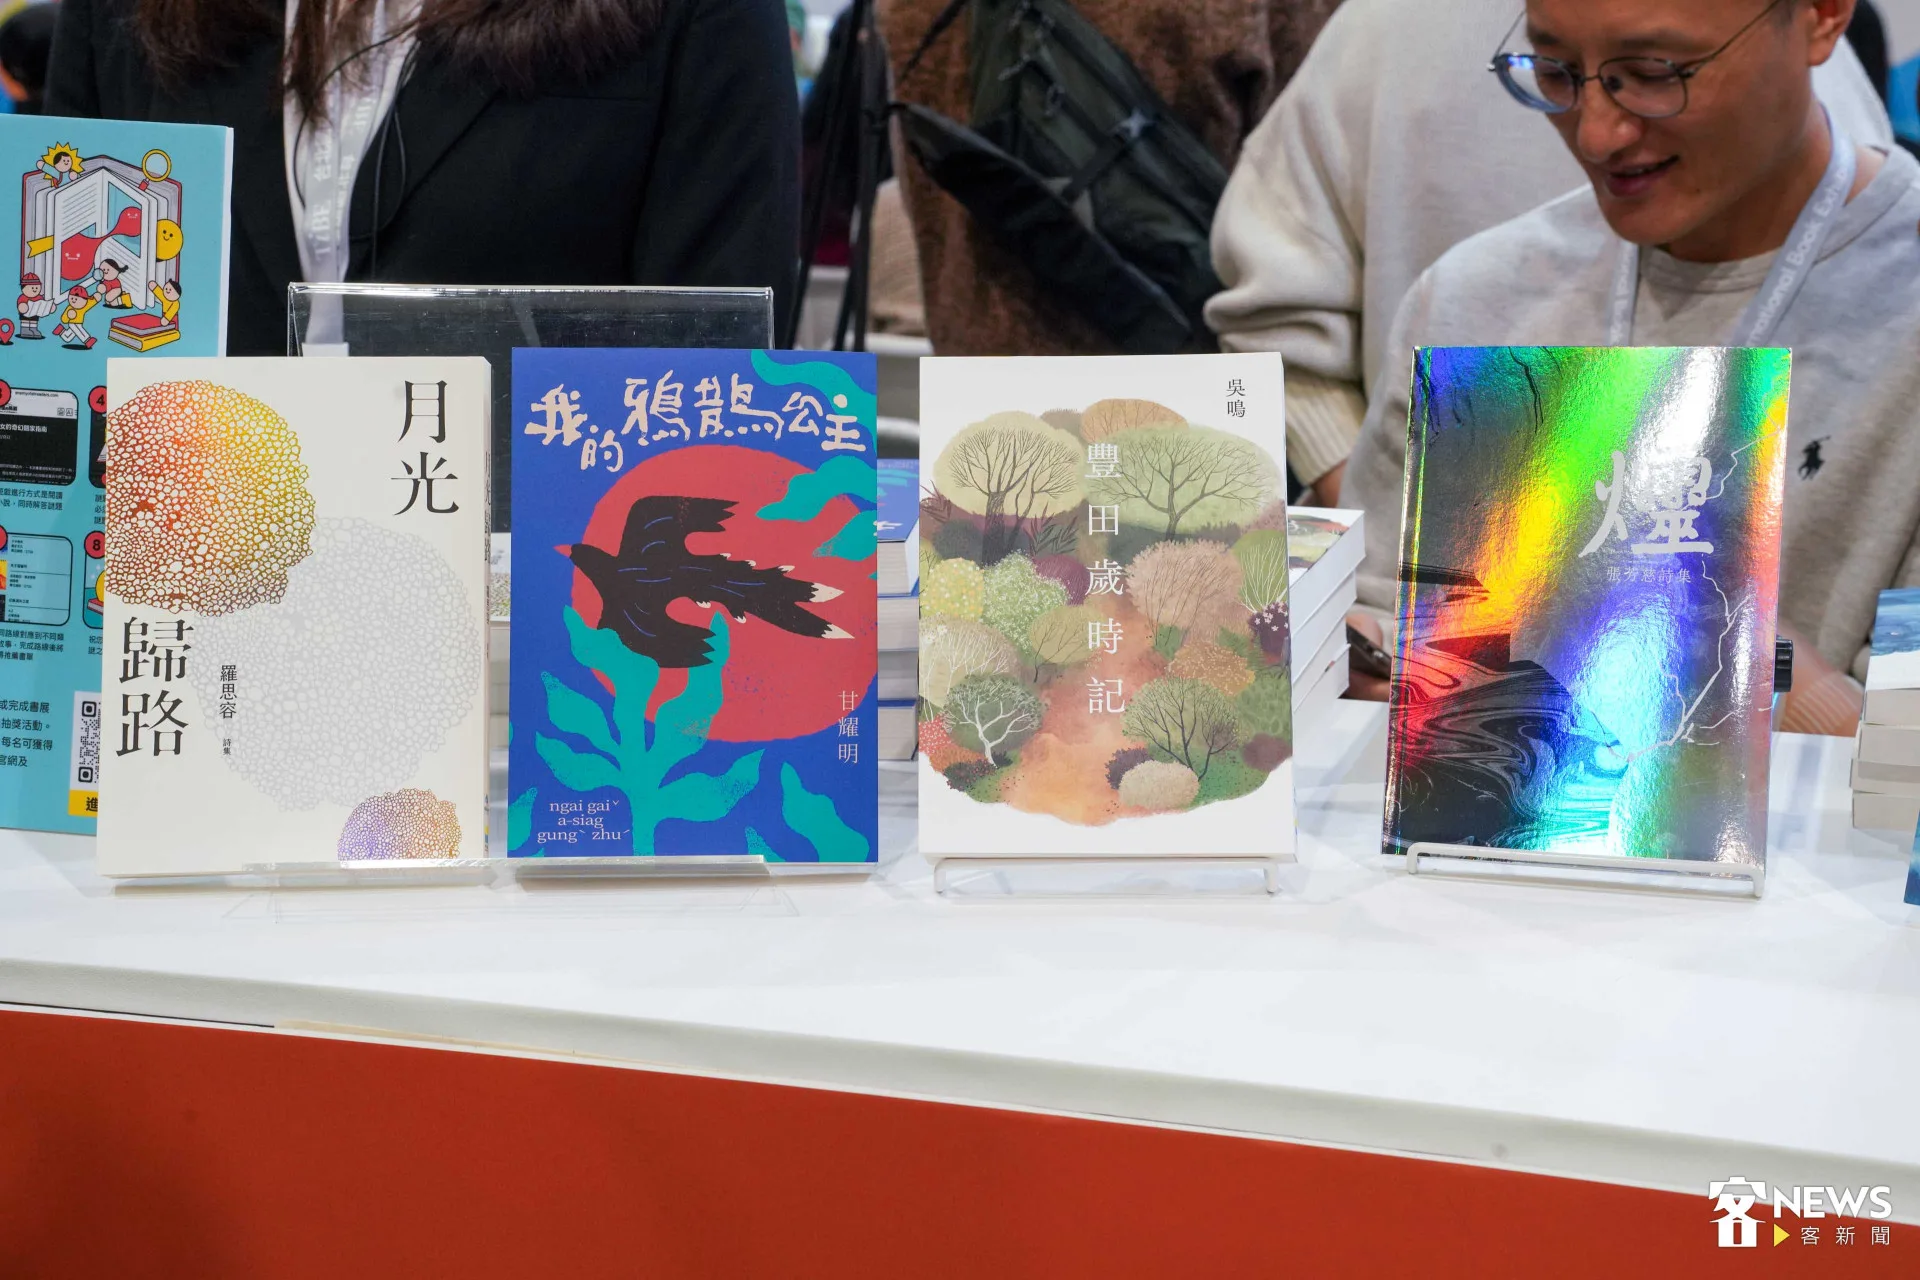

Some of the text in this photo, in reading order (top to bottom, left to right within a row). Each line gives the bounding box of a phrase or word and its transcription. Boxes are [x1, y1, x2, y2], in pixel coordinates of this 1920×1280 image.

[1786, 222, 1825, 267] Book
[96, 394, 105, 406] 4
[1226, 377, 1246, 418] 吳鳴
[390, 379, 459, 517] 月光
[92, 539, 101, 551] 8
[1083, 442, 1126, 716] 豐田歲時記
[1606, 566, 1692, 584] 張芳慈詩集
[115, 616, 195, 757] 歸路
[0, 700, 50, 714] 或完成書展
[219, 664, 238, 756] 羅思容 詩集
[837, 690, 859, 765] 甘耀明
[1, 736, 53, 751] 每名可獲得
[86, 796, 98, 813] 進
[549, 799, 583, 814] ngai
[557, 814, 604, 829] a-siag
